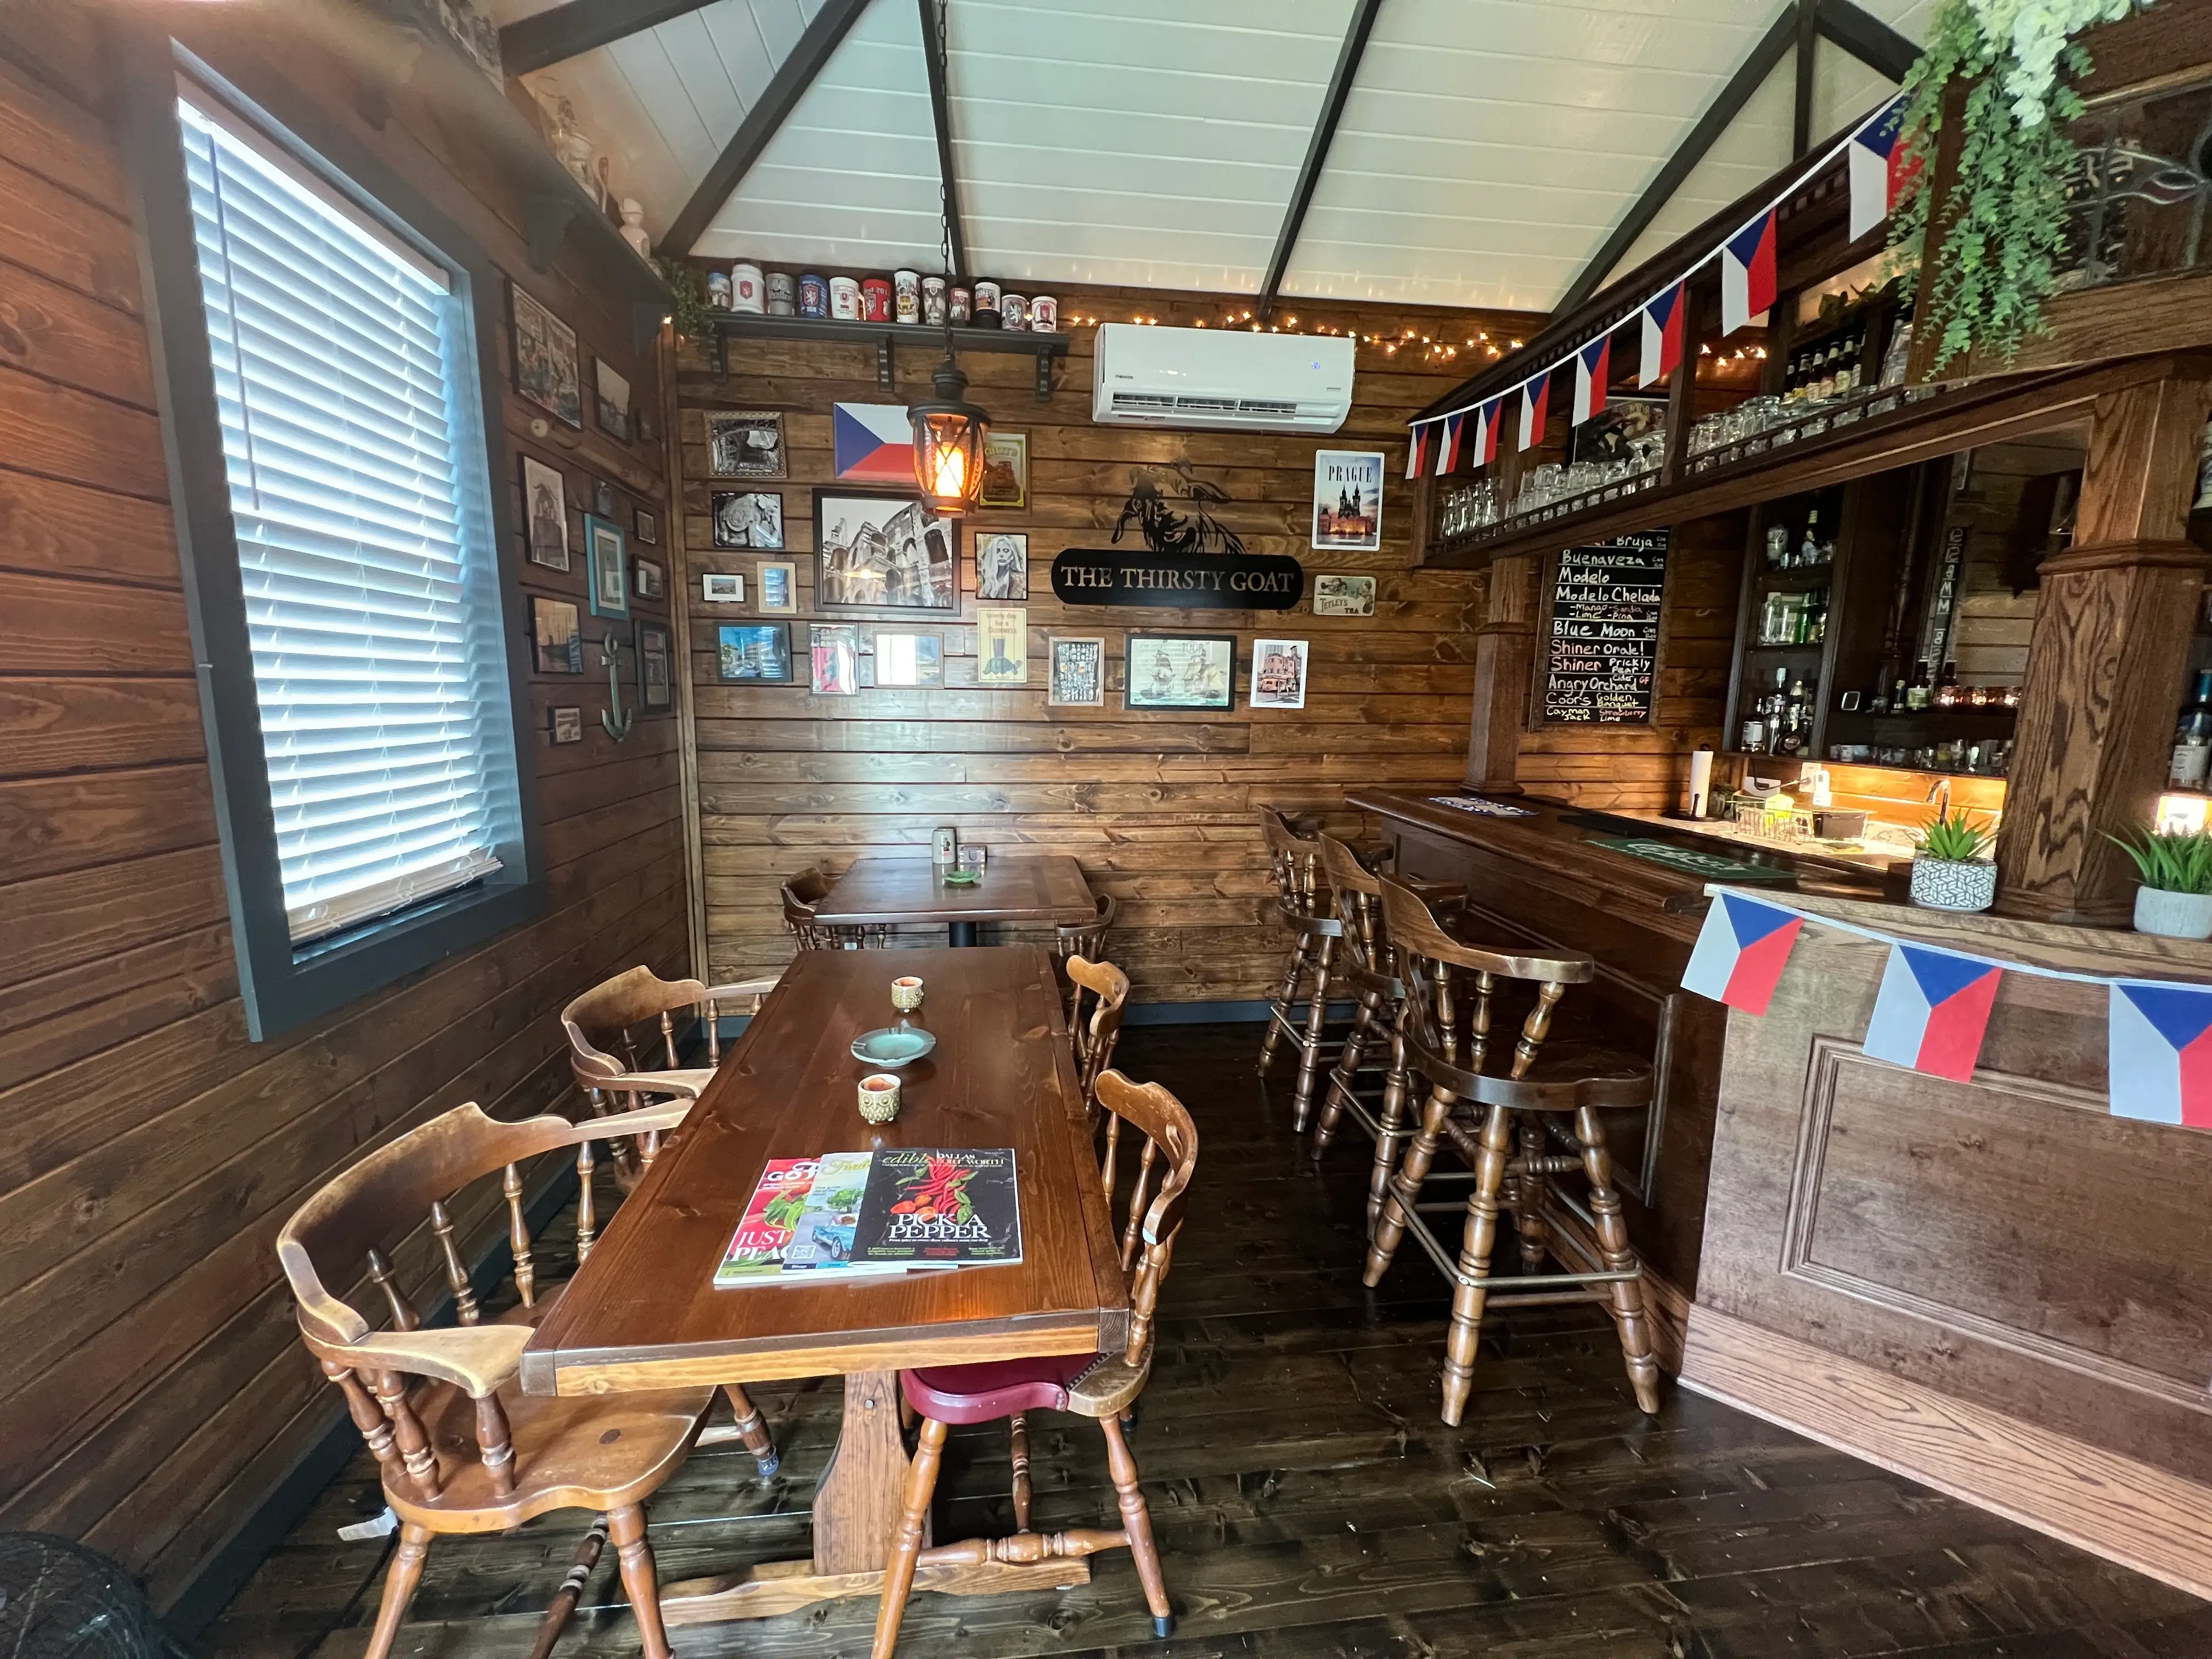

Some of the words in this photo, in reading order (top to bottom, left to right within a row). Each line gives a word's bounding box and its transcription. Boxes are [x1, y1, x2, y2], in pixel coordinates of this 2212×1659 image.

[1328, 465, 1373, 482] PRAGUE
[1617, 535, 1653, 552] Bruja
[1562, 549, 1645, 566] Buenaveza
[1061, 566, 1113, 588] THE
[1120, 568, 1225, 591] THIRSTY
[1231, 572, 1294, 592] GOAT
[1558, 567, 1610, 584] Modelo
[1555, 585, 1609, 601] Modelo
[1611, 586, 1661, 602] Chelada
[1553, 620, 1593, 636] Blue
[1600, 623, 1635, 637] Moon
[1550, 639, 1600, 654] Shiner
[1550, 656, 1601, 672] Shiner
[1609, 657, 1650, 672] Prickly
[1612, 665, 1639, 674] Pear
[1548, 674, 1588, 697] Angry
[1589, 677, 1638, 691] Orchard
[1546, 692, 1592, 706] Coors
[1596, 692, 1632, 702] Golden
[1597, 698, 1639, 712] Banquet
[1547, 706, 1590, 716] Cayman
[898, 1214, 956, 1226] PICK
[963, 1214, 986, 1226] A
[737, 1230, 791, 1247] JUST
[888, 1225, 992, 1239] PEPPER
